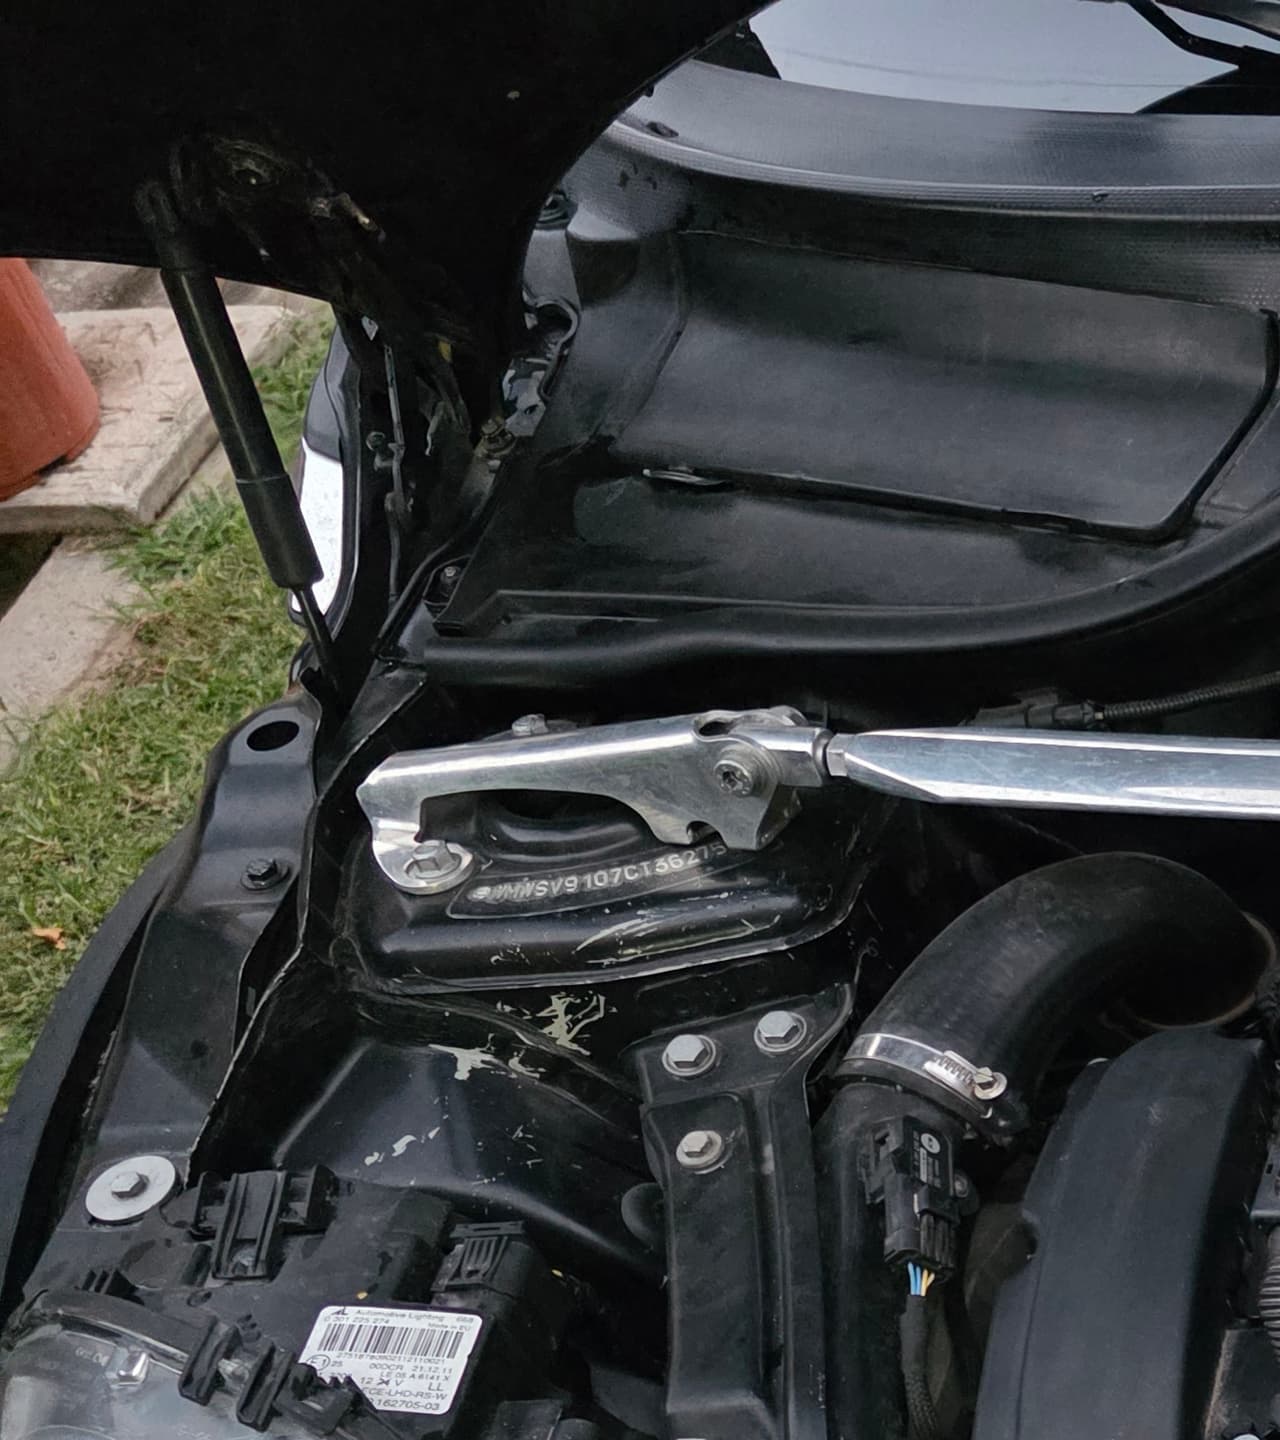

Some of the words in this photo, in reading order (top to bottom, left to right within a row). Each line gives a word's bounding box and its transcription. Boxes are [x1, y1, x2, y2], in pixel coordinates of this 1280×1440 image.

[356, 1309, 406, 1318] Automotive
[408, 1312, 445, 1322] Lighting
[411, 1365, 452, 1374] 21.12.11
[428, 1382, 443, 1391] LL
